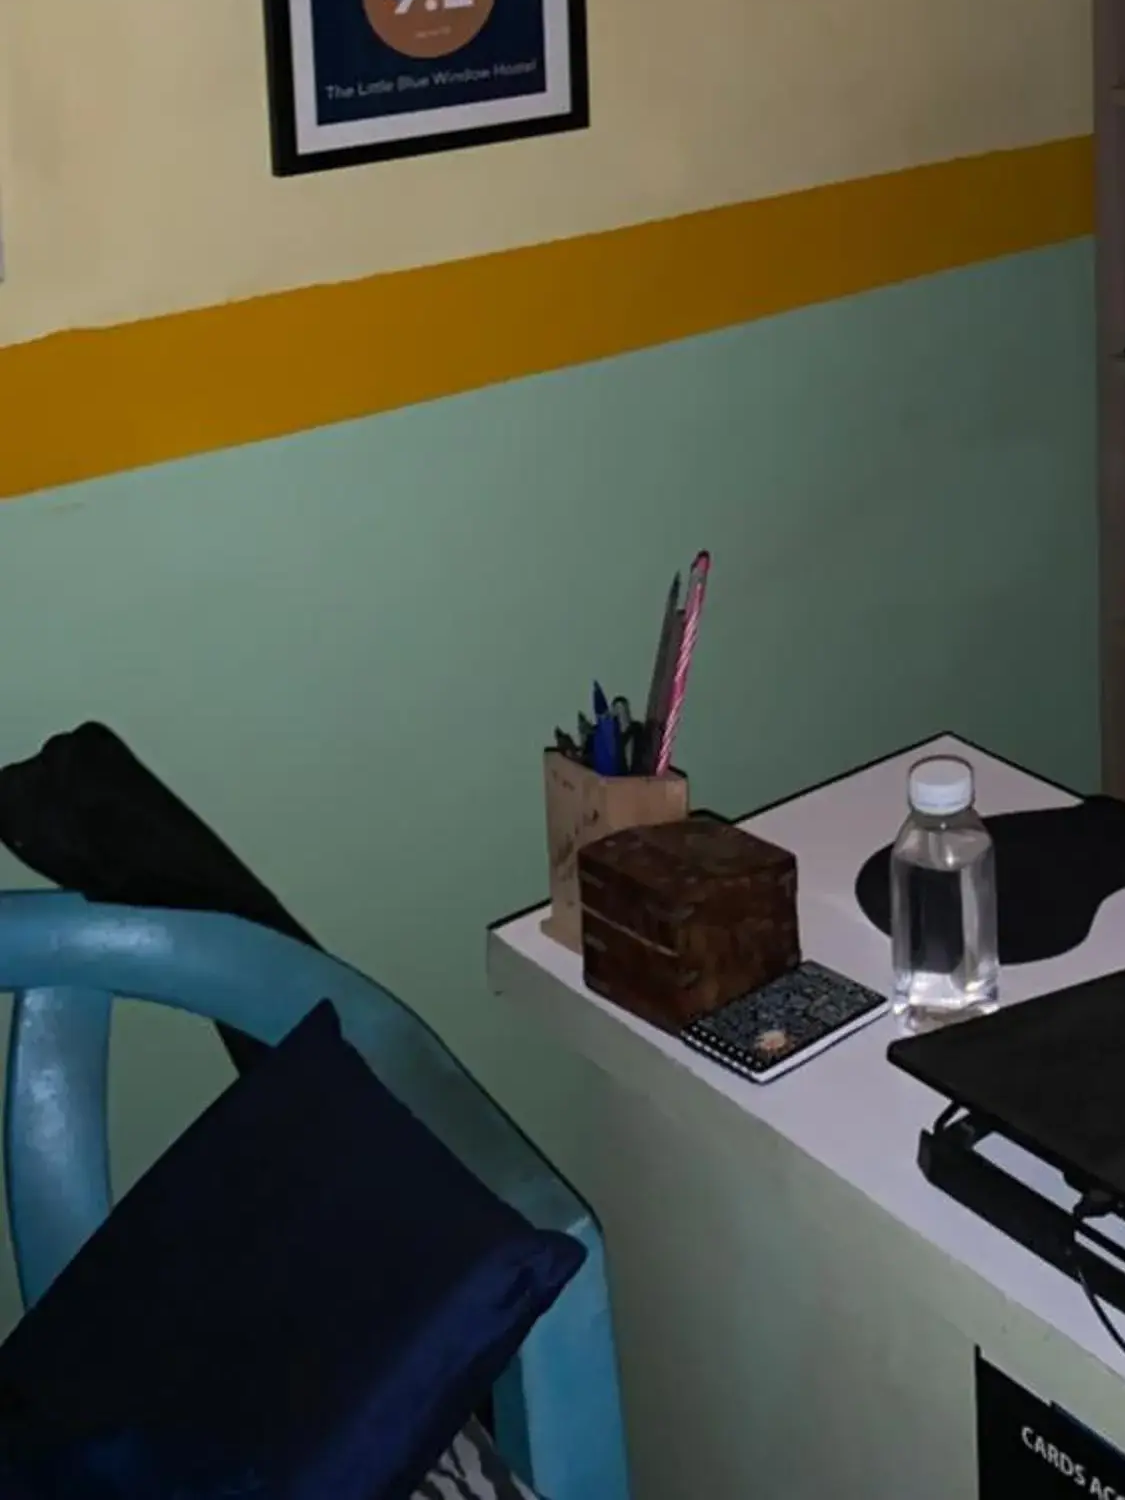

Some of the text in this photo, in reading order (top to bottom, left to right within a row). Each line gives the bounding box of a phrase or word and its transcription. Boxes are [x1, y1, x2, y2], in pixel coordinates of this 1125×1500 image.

[325, 84, 354, 100] The
[357, 78, 394, 96] Little
[396, 74, 430, 92] Blue
[431, 67, 490, 87] Window
[1021, 1425, 1086, 1487] CARDS
